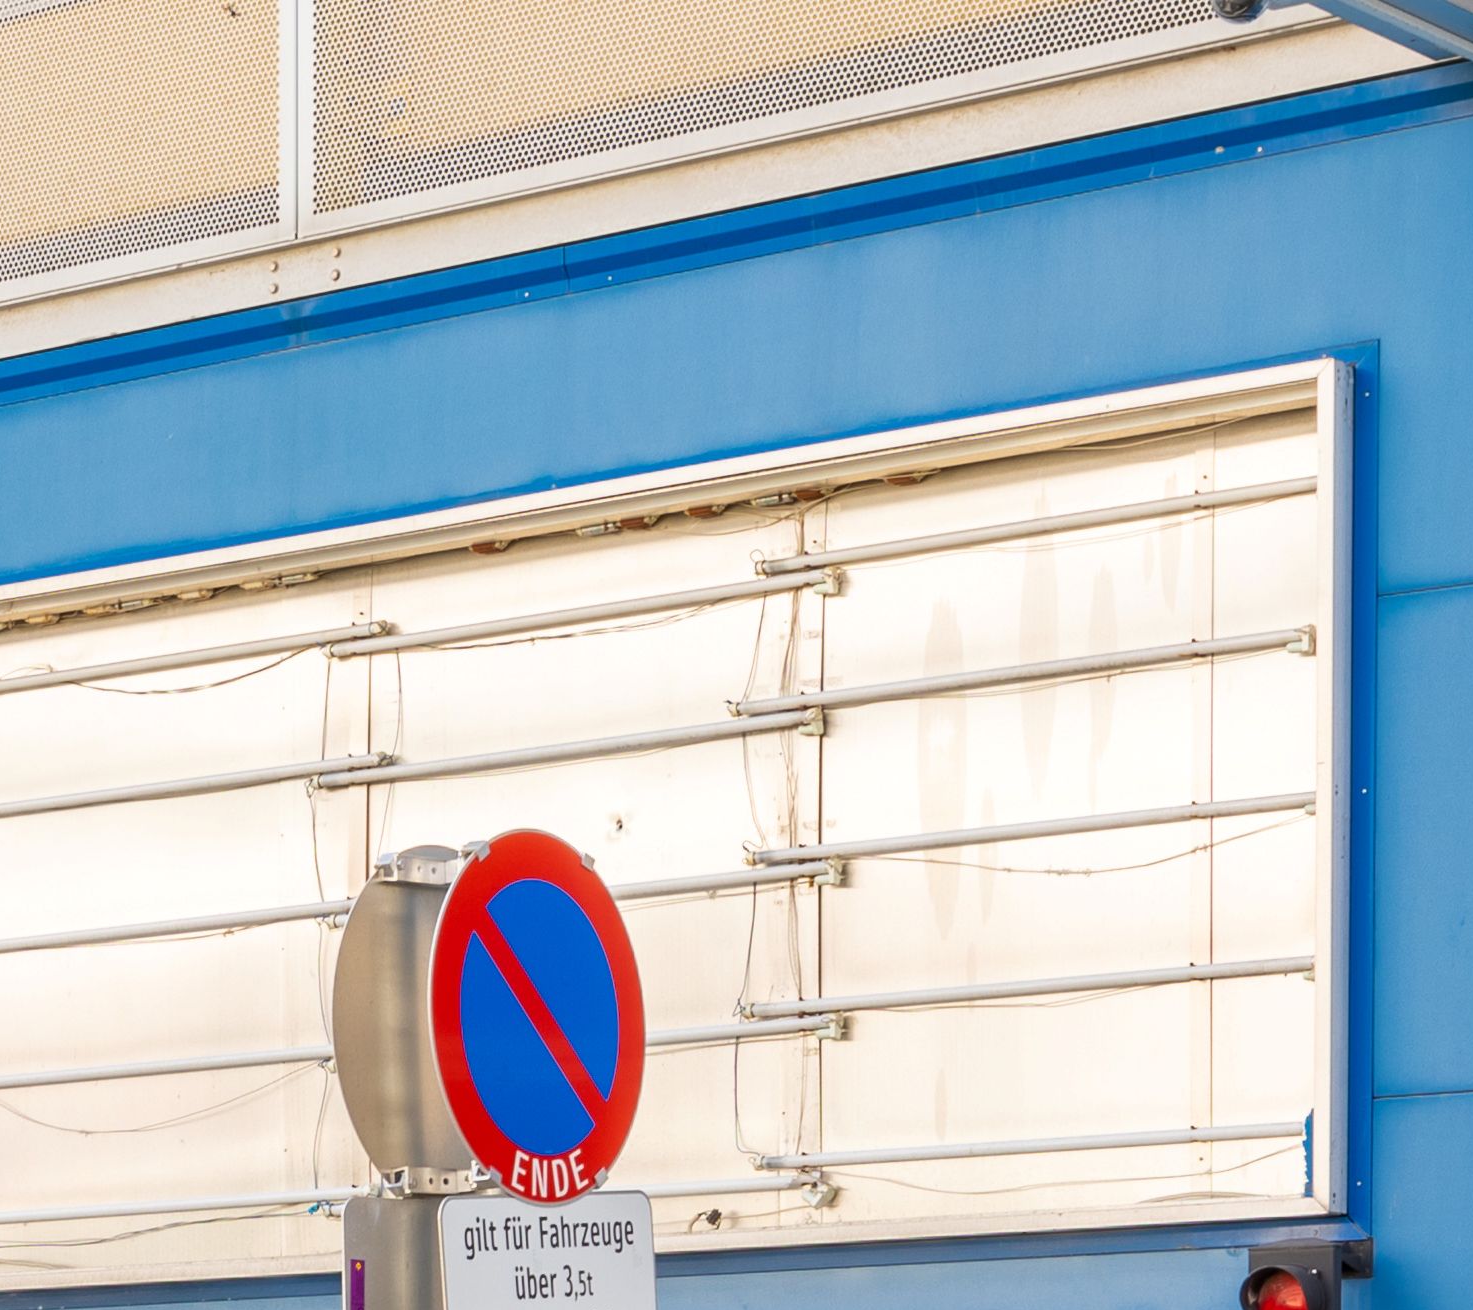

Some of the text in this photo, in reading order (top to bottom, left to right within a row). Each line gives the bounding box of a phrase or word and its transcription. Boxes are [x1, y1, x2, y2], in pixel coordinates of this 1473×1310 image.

[511, 1148, 590, 1199] ENDE
[464, 1216, 634, 1260] gilt für Fahrzeuge
[515, 1265, 594, 1302] über 3,5t
